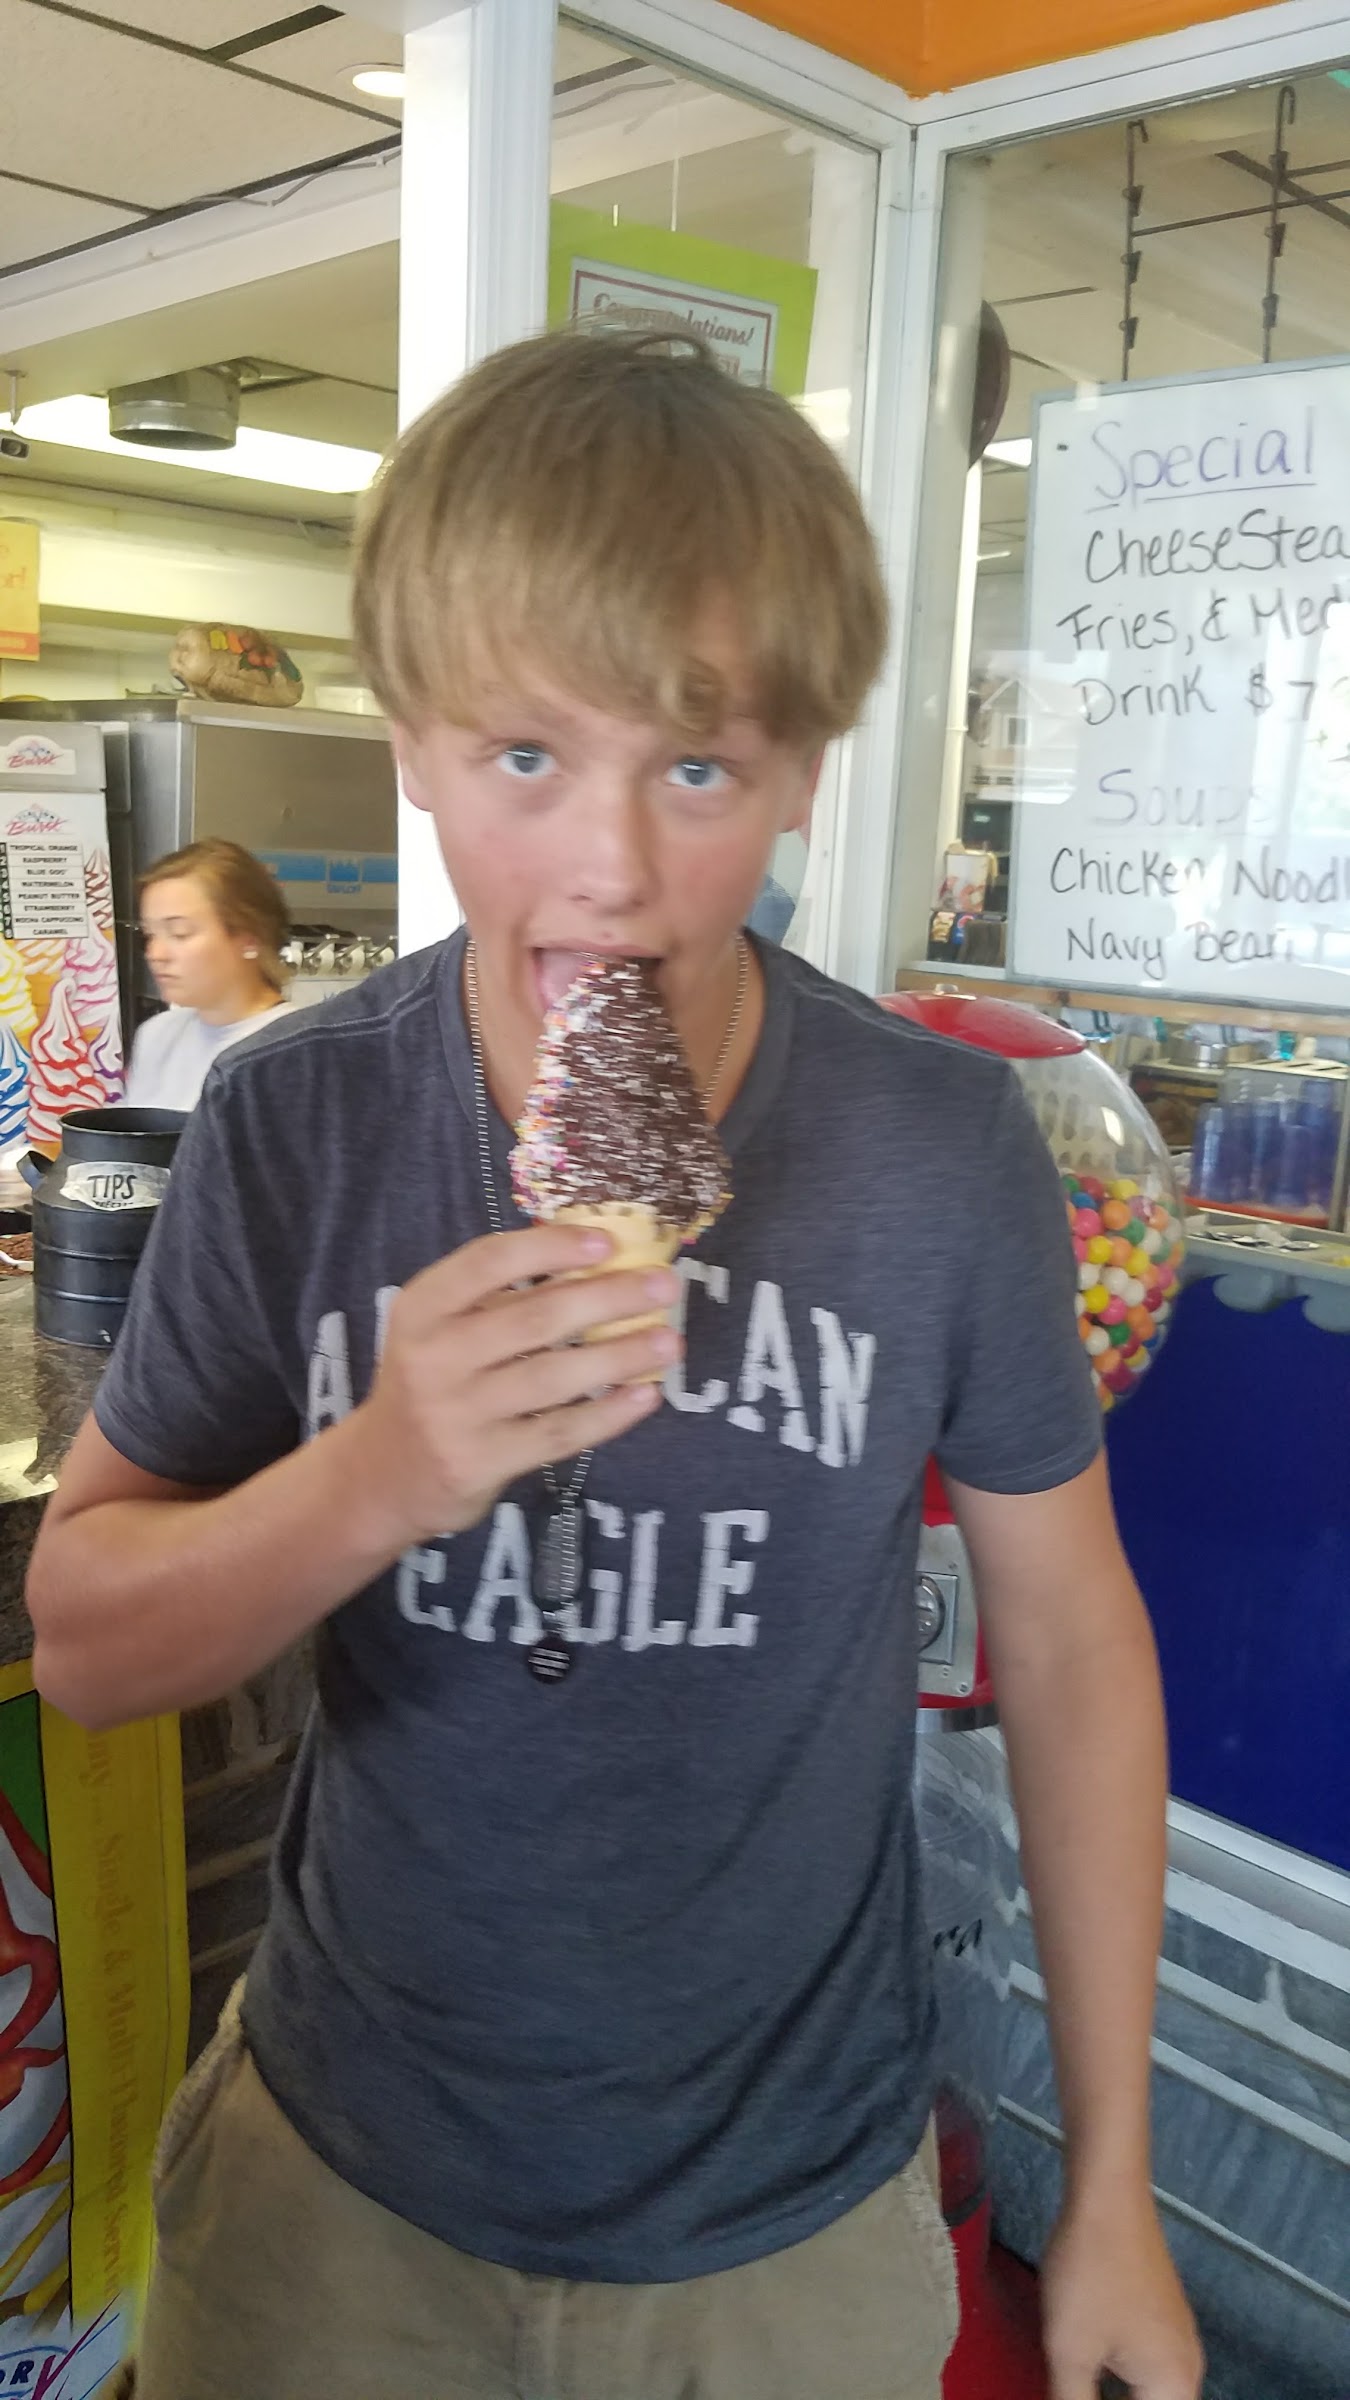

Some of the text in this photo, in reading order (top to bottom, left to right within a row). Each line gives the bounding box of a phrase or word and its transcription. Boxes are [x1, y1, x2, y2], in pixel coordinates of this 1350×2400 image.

[1091, 406, 1314, 510] Special
[1085, 508, 1350, 583] CheeseStea
[1056, 603, 1194, 656] Fries,
[1072, 665, 1217, 725] Drink
[1050, 848, 1206, 897] Chicken
[1067, 917, 1166, 980] Navy
[87, 1174, 138, 1199] TIPS
[307, 1256, 877, 1468] ACAN
[396, 1499, 772, 1652] EAGLE
